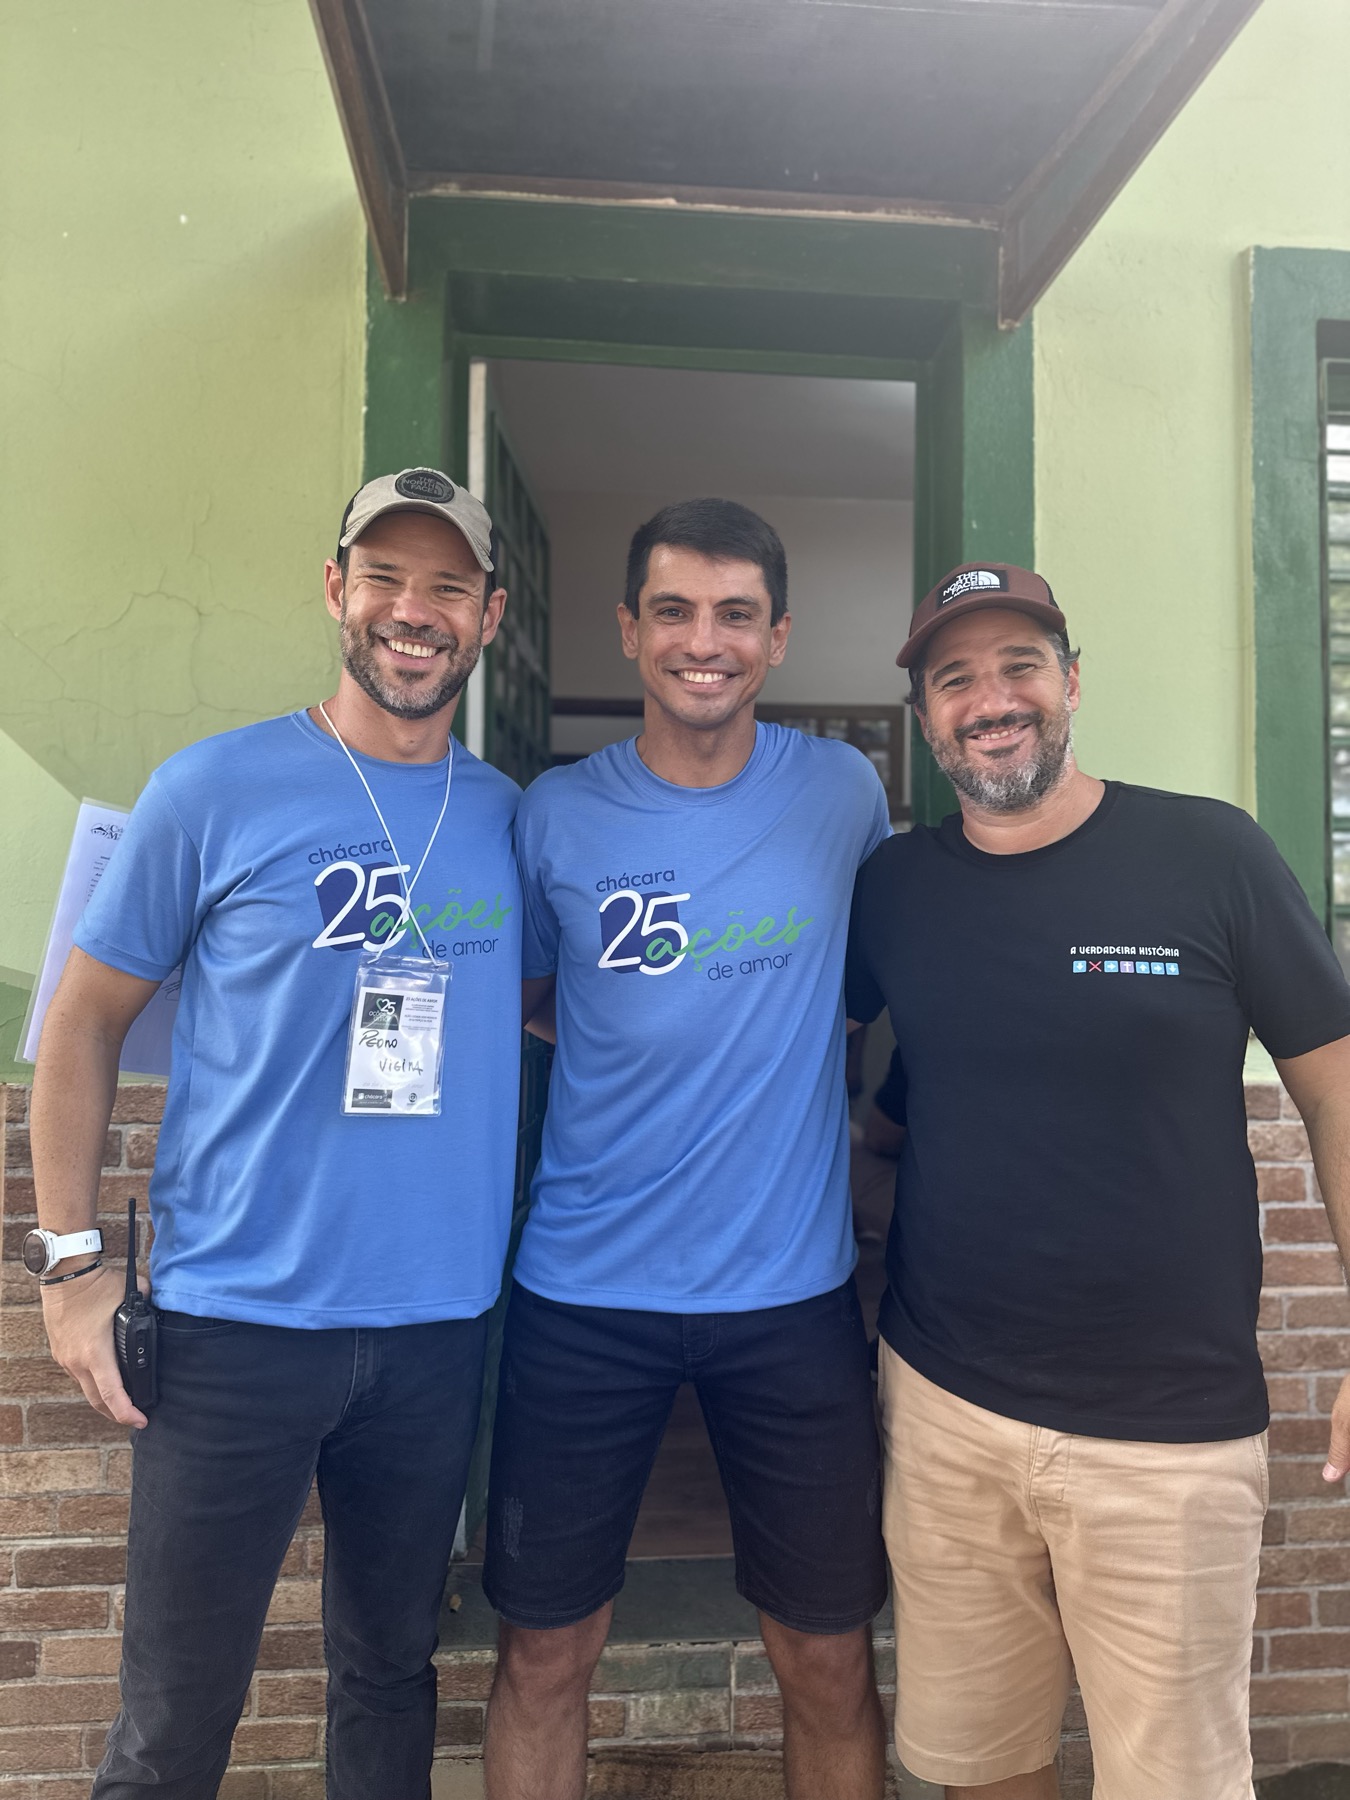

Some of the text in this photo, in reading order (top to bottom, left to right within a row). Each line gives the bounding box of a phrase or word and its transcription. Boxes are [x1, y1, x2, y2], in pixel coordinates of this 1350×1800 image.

[404, 479, 435, 489] NORTH
[411, 484, 433, 493] FACE
[419, 476, 435, 484] THE
[956, 571, 978, 580] THE
[943, 575, 978, 597] NORTH
[951, 580, 978, 595] FACE
[308, 839, 394, 865] chácara
[595, 869, 676, 892] chácara
[311, 860, 411, 953] 25
[597, 889, 815, 976] 25 ações
[421, 937, 499, 959] de amor
[1070, 946, 1076, 955] A
[1138, 945, 1180, 957] HISTÓRIA
[707, 952, 793, 981] de amor
[380, 998, 396, 1015] 25
